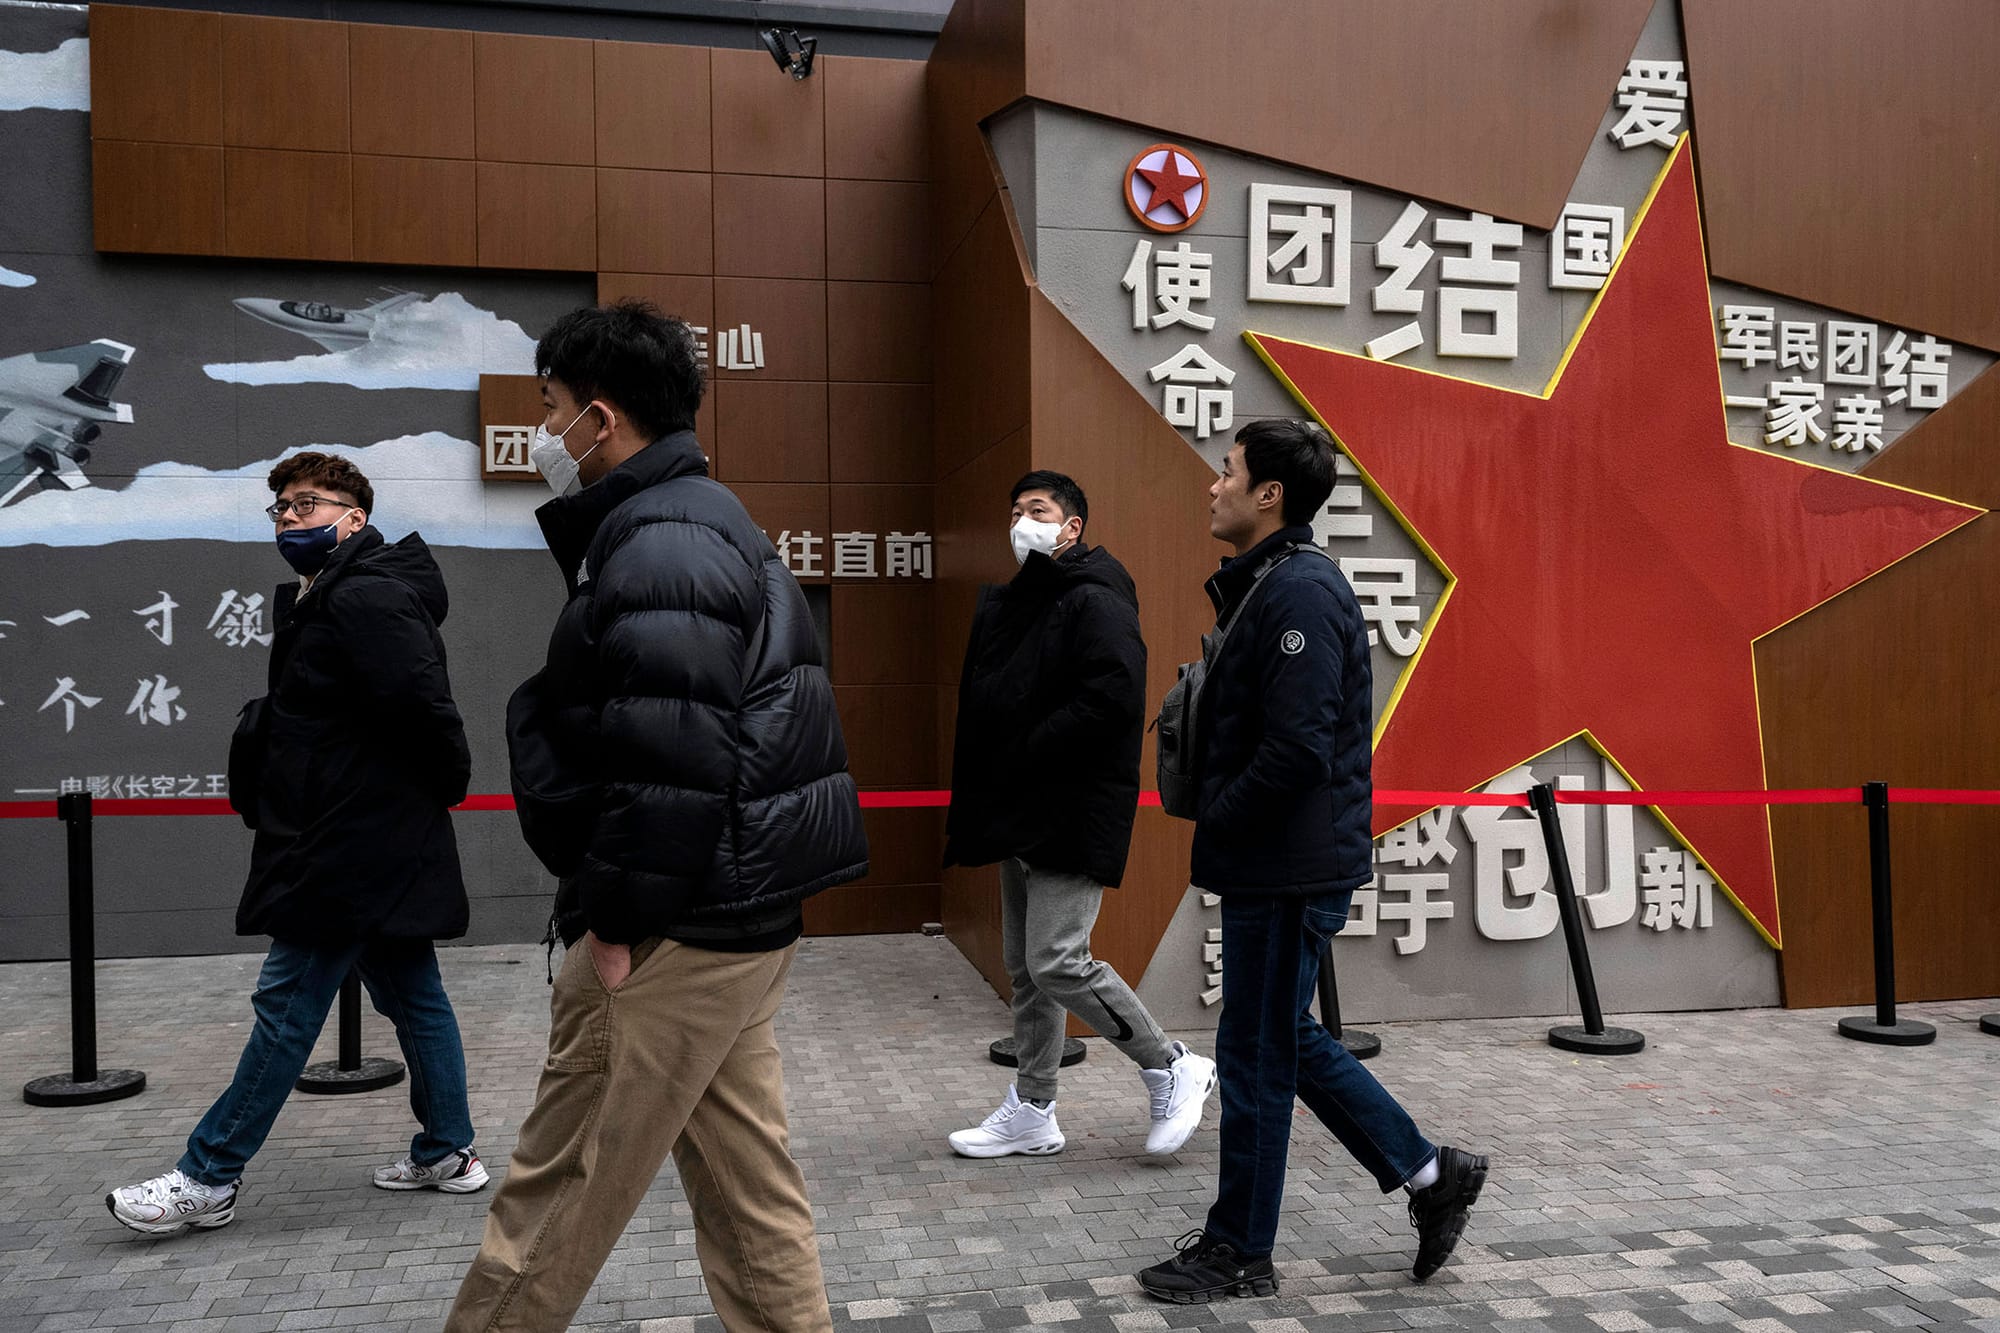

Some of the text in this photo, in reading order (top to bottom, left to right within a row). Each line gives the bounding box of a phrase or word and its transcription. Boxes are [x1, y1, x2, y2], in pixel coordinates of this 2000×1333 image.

[685, 322, 765, 370] 心
[1719, 304, 1952, 409] 军民团结
[1725, 376, 1885, 453] 一家亲
[763, 529, 933, 579] 往直前
[0, 589, 274, 648] 一寸领
[0, 674, 188, 734] 个你
